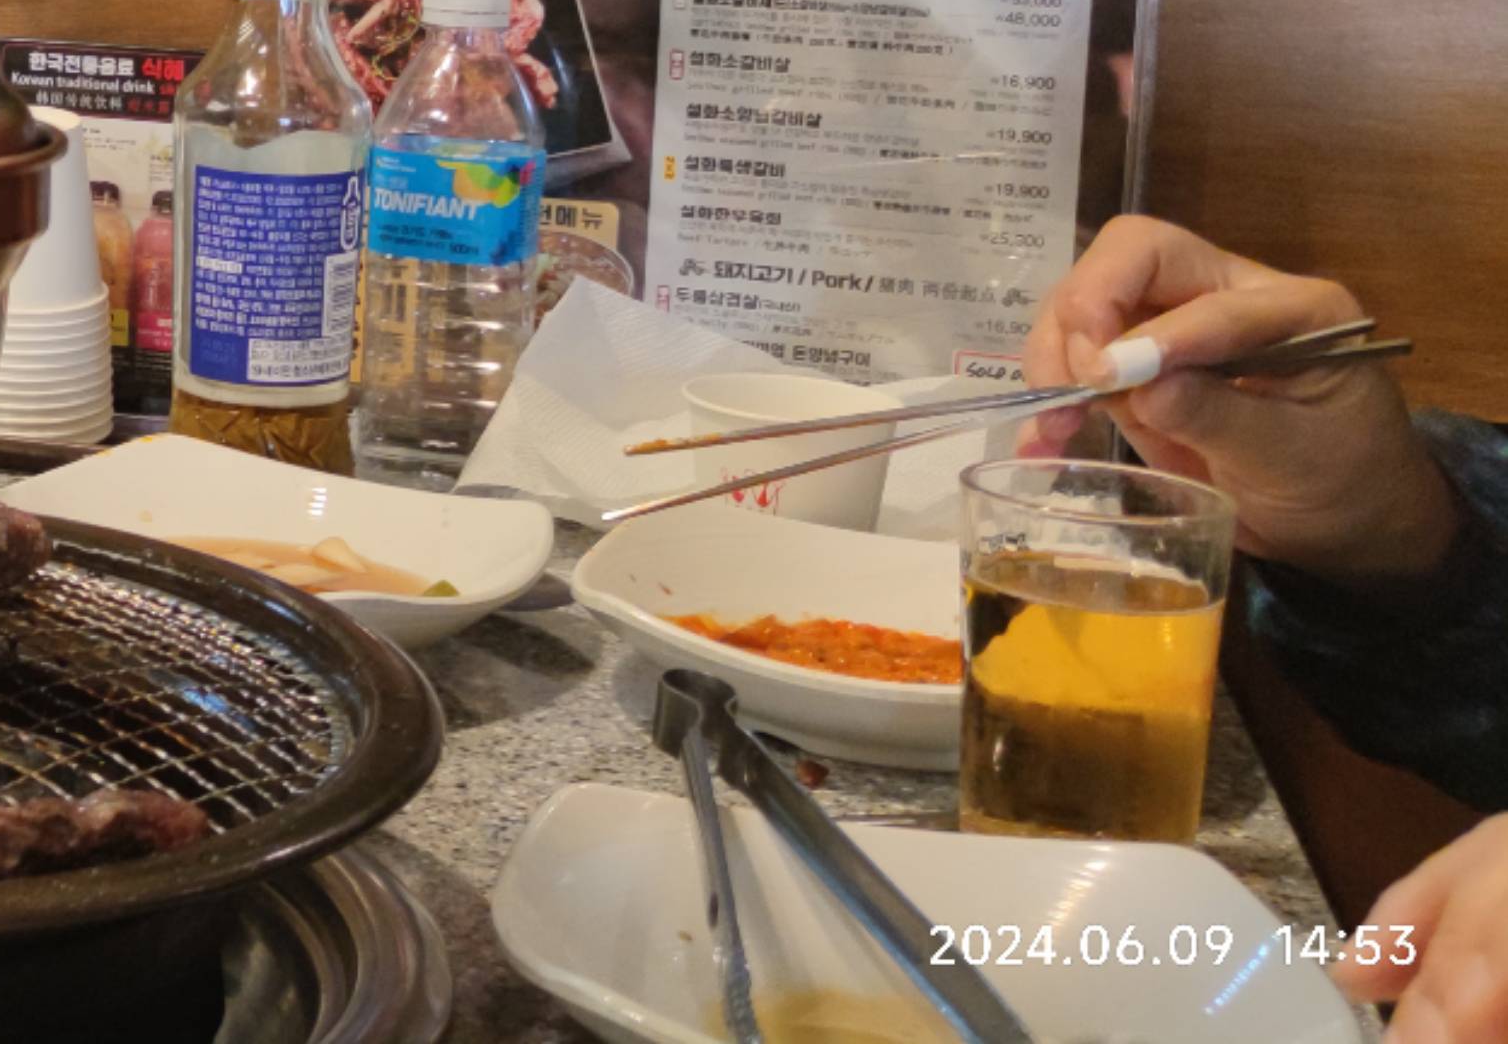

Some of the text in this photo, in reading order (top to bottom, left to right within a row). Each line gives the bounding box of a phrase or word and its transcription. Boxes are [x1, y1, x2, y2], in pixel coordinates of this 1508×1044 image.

[28, 51, 135, 77] 한국전통음료
[690, 50, 791, 74] 설화소갈비살
[10, 71, 55, 87] Korean
[56, 74, 121, 93] traditional
[122, 79, 156, 95] drink
[373, 187, 480, 221] TONIFIANT
[713, 260, 794, 284] 돼지고기
[965, 361, 1007, 379] SOLD
